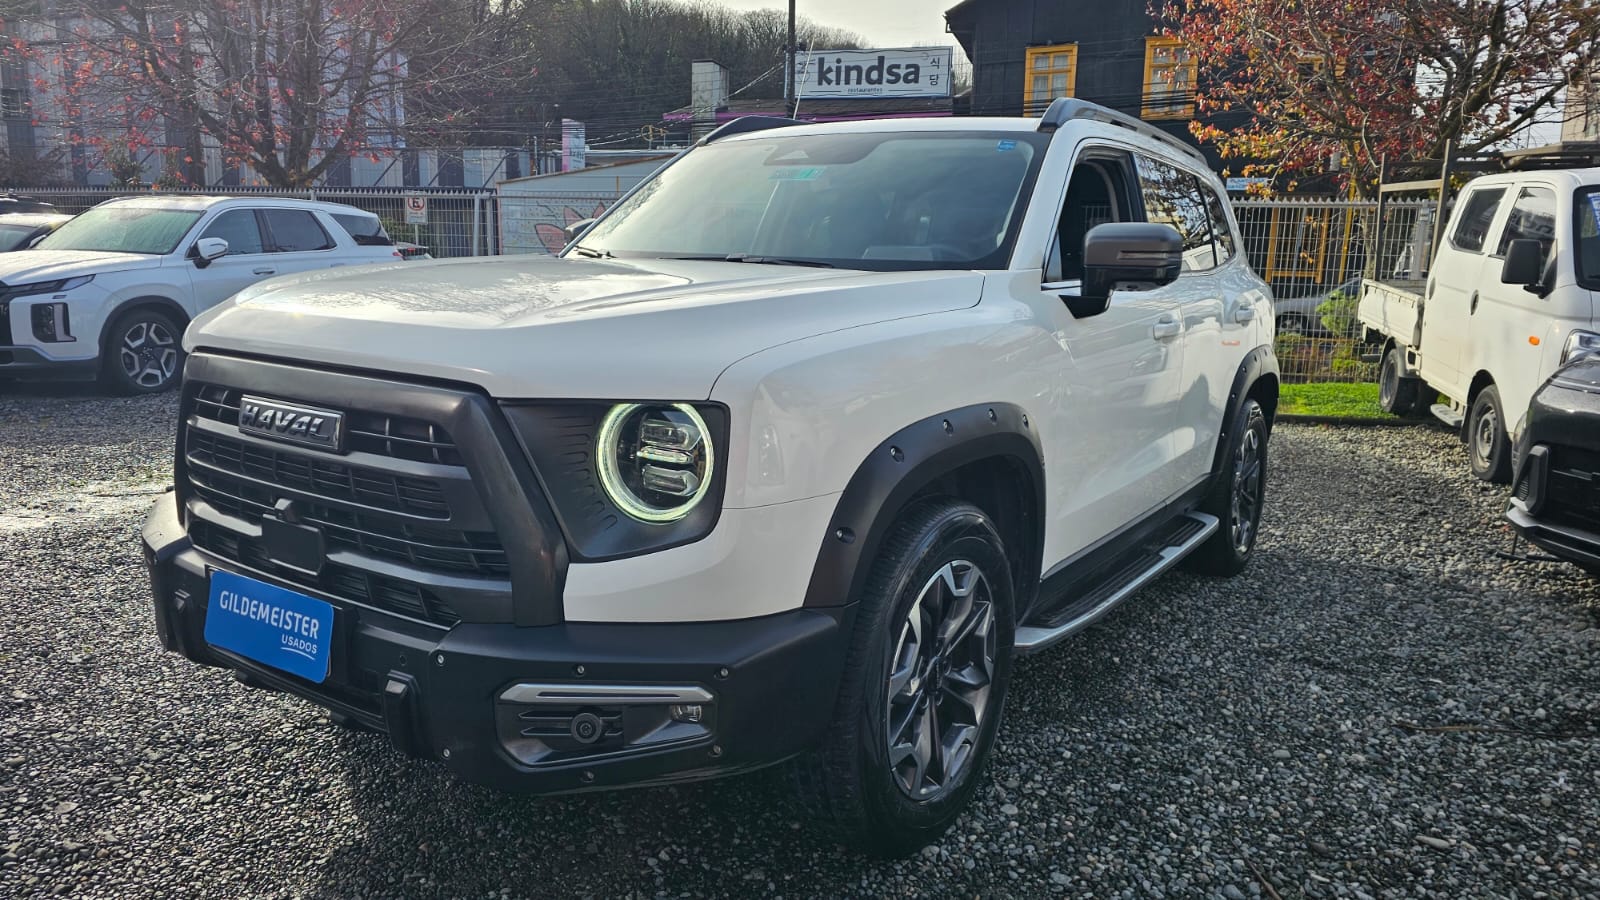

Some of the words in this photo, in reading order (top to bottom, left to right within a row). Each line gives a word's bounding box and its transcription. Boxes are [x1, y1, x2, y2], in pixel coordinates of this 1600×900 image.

[817, 55, 920, 86] kindsa
[241, 404, 329, 441] HAVAL
[219, 590, 320, 640] GILDEMEISTER
[281, 633, 318, 655] USADOS
